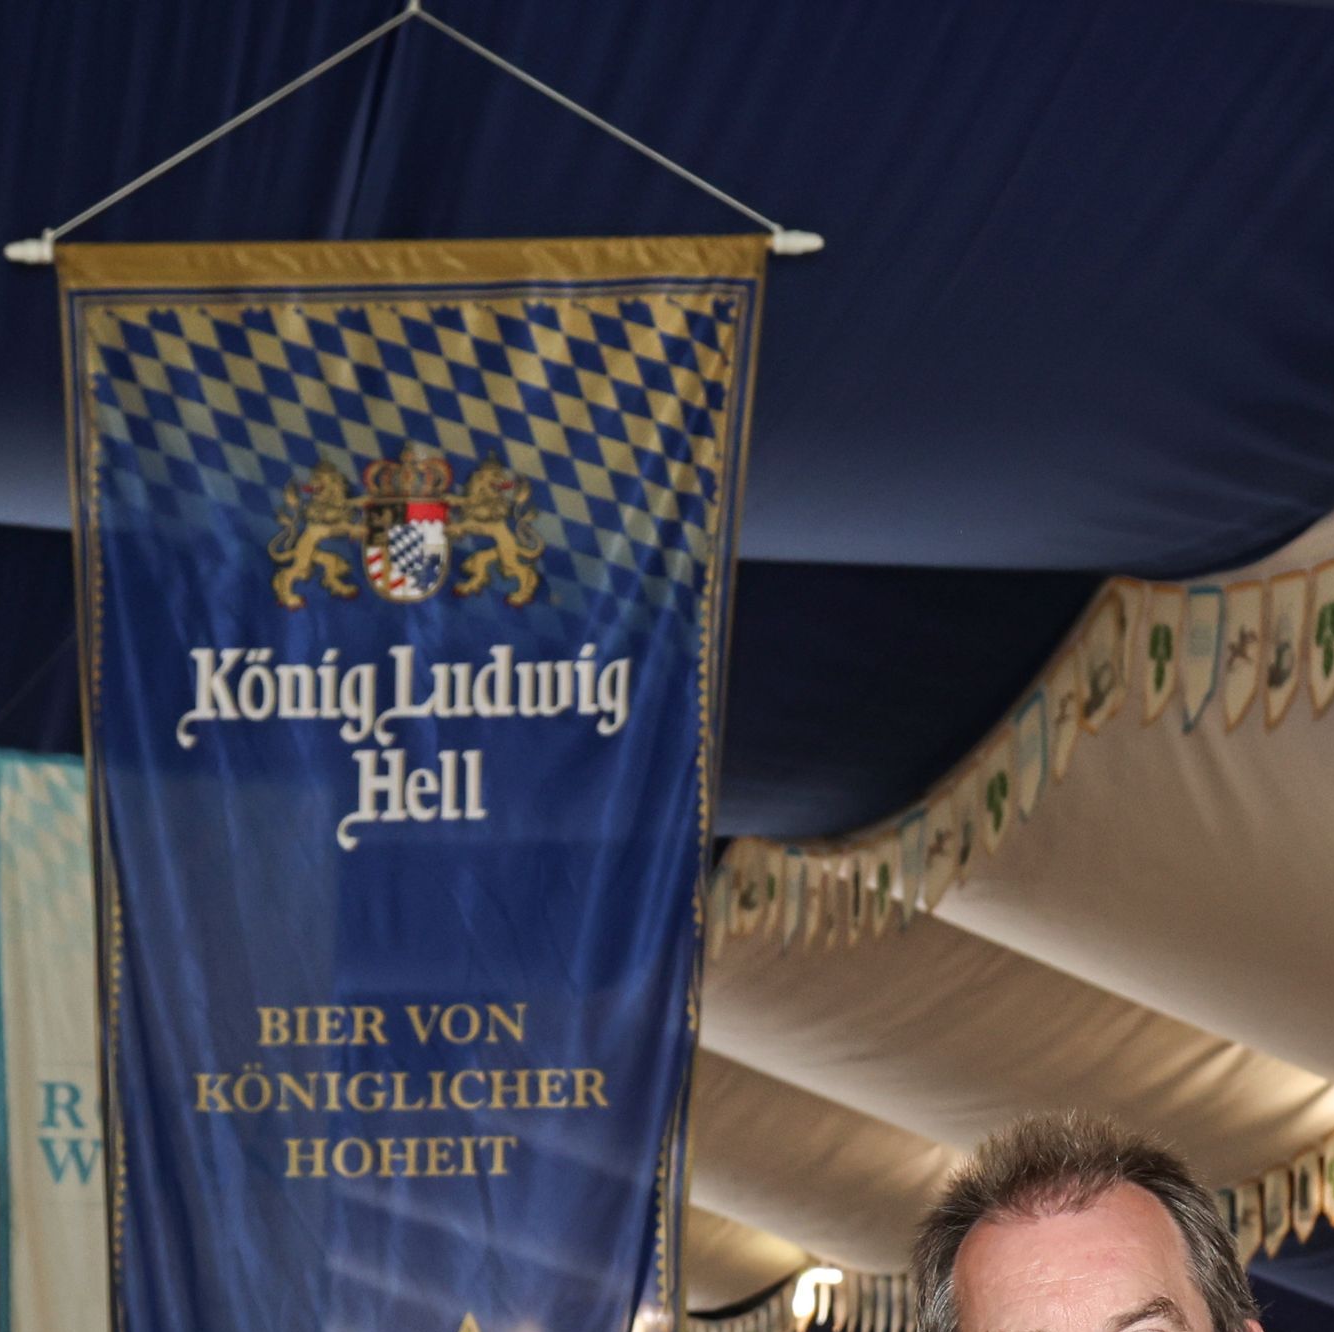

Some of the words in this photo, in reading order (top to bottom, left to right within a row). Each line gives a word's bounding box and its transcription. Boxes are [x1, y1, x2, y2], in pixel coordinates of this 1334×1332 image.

[176, 647, 378, 749] König
[374, 643, 632, 747] Ludwig
[336, 749, 488, 850] Hell
[257, 1005, 388, 1048] BIER
[406, 1002, 529, 1045] VON
[193, 1063, 610, 1113] KÖNIGLICHER
[283, 1134, 518, 1180] HOHEIT
